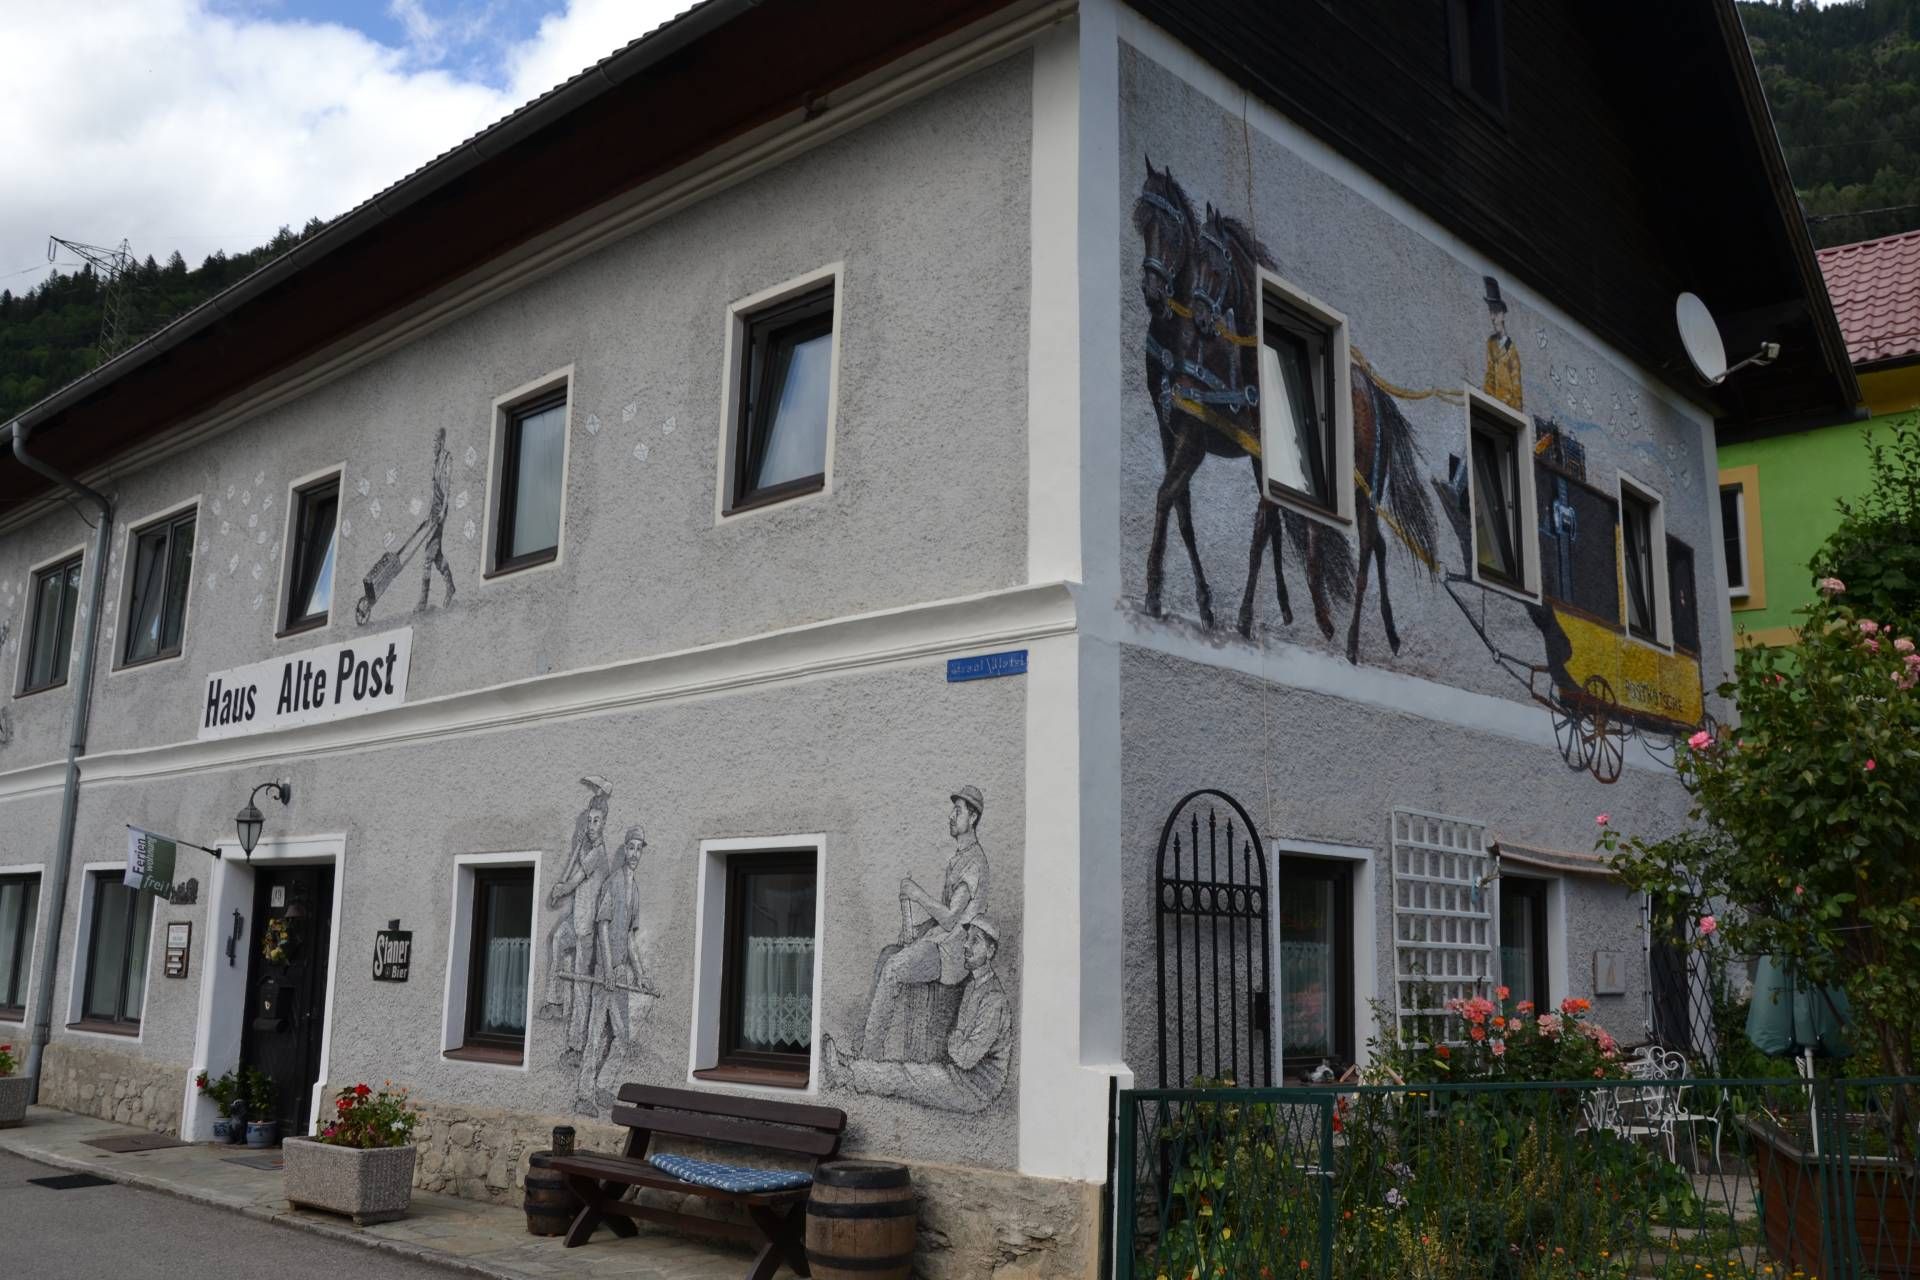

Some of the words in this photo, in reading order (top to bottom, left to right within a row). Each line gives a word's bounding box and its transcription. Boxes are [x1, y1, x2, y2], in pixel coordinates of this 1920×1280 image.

[205, 679, 257, 728] Haus
[277, 660, 327, 715] Alte
[334, 643, 397, 704] Post
[132, 838, 146, 875] Ferien
[391, 965, 408, 978] Bier
